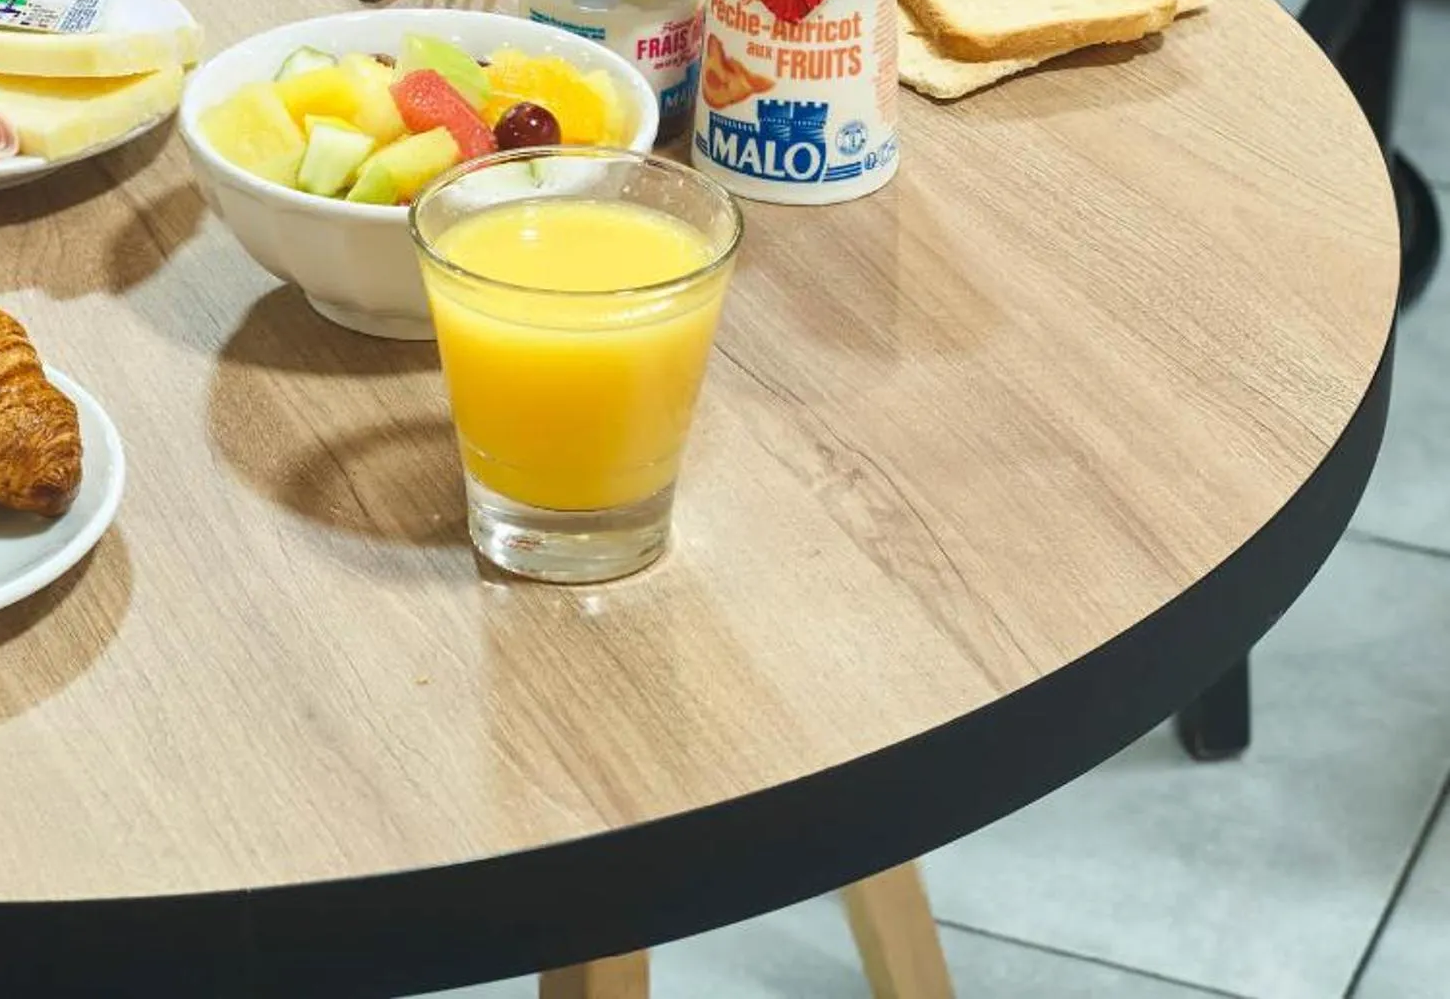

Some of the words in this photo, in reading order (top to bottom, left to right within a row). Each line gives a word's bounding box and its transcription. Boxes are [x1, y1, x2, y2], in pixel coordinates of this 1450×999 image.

[636, 29, 689, 61] FRAIS
[745, 40, 773, 61] aux
[775, 44, 863, 81] FRUITS
[711, 126, 822, 181] MALO
